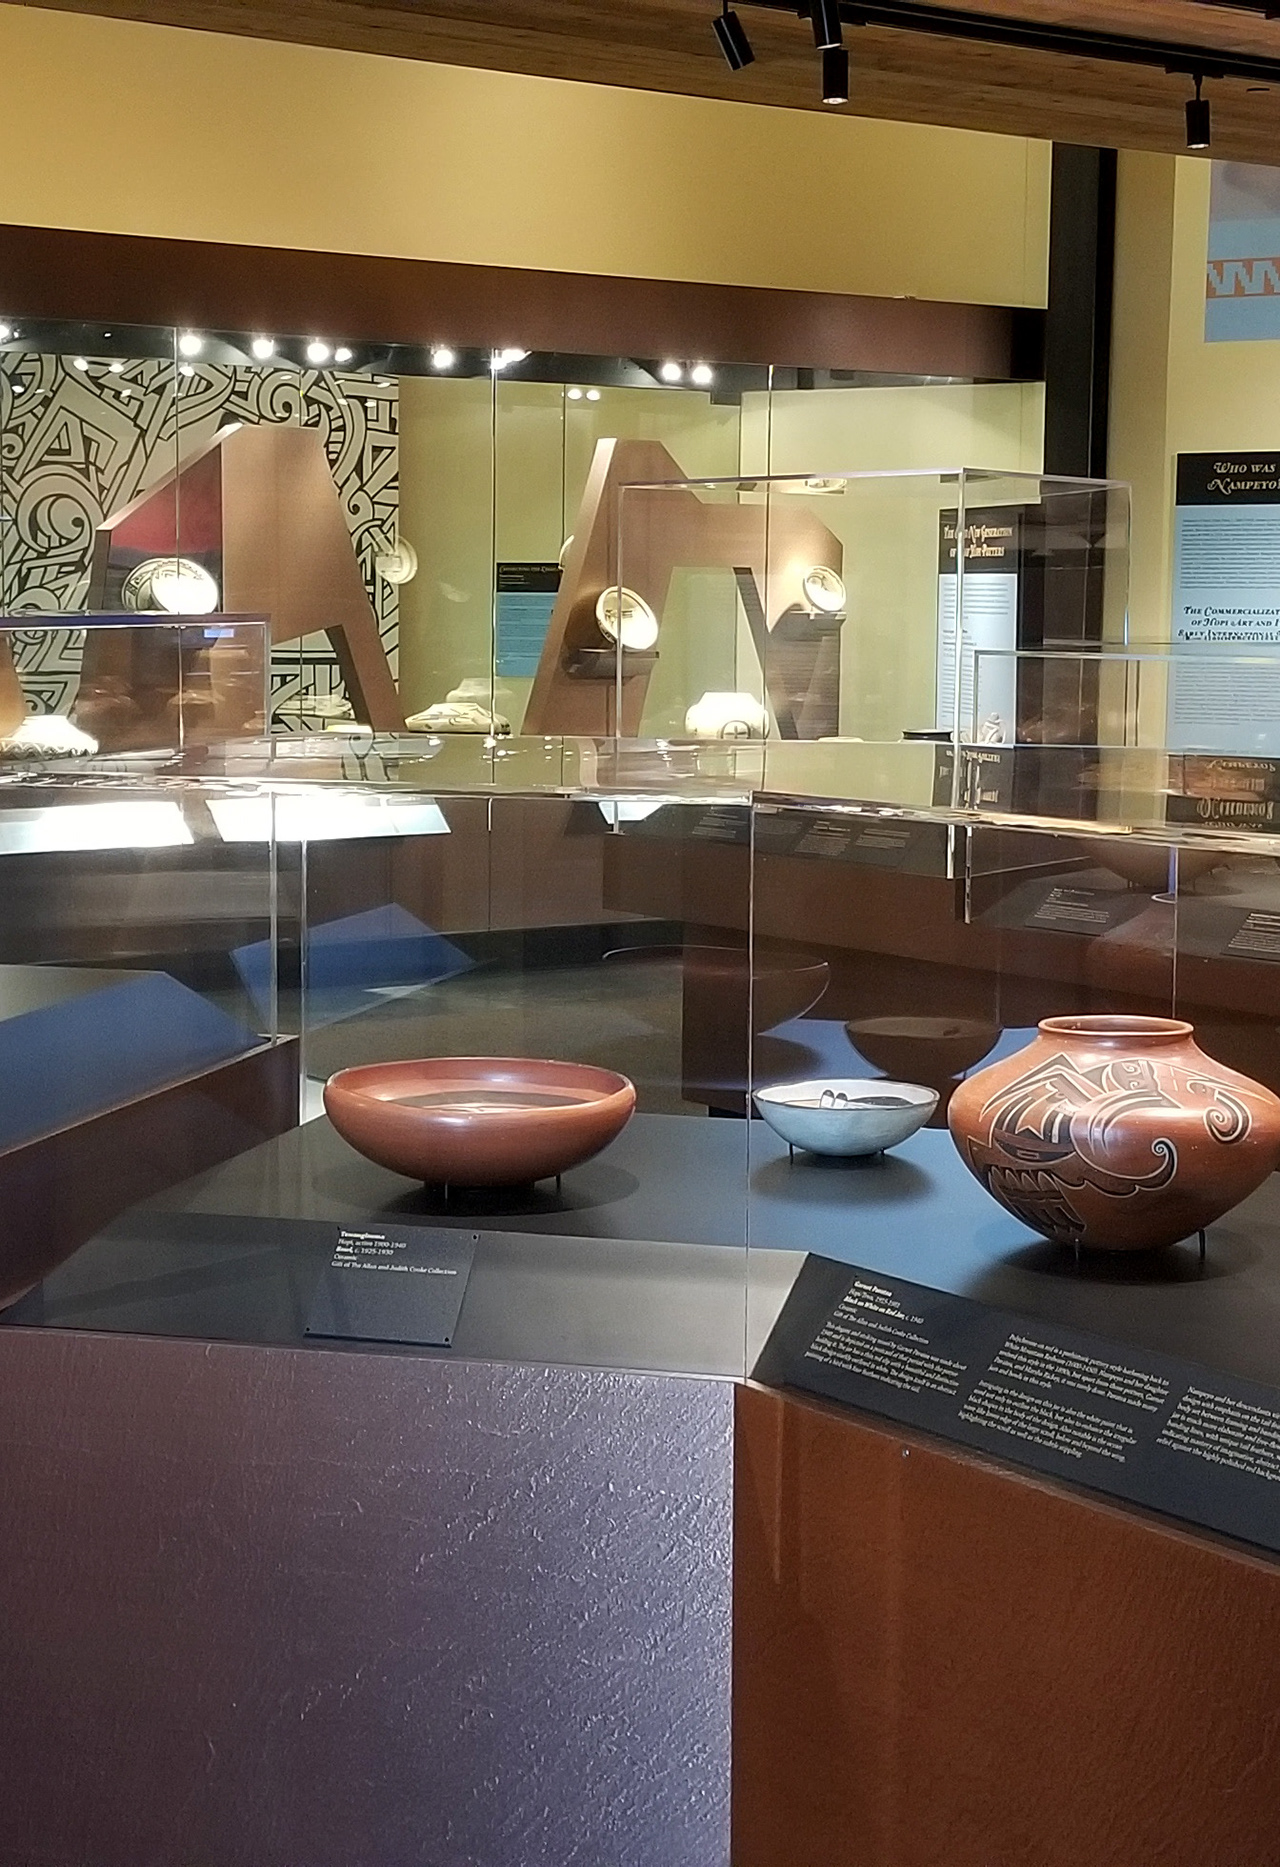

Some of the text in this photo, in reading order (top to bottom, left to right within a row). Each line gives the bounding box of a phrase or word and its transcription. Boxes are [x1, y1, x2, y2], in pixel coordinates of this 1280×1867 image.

[1213, 462, 1276, 474] WHO WAS
[1183, 605, 1202, 615] THE
[1190, 619, 1203, 627] OF
[1202, 618, 1229, 627] HOPI
[1230, 618, 1254, 628] ART
[844, 1296, 858, 1304] Black
[864, 1302, 879, 1310] White
[838, 1304, 857, 1313] Ceramic
[906, 1333, 929, 1344] Collection
